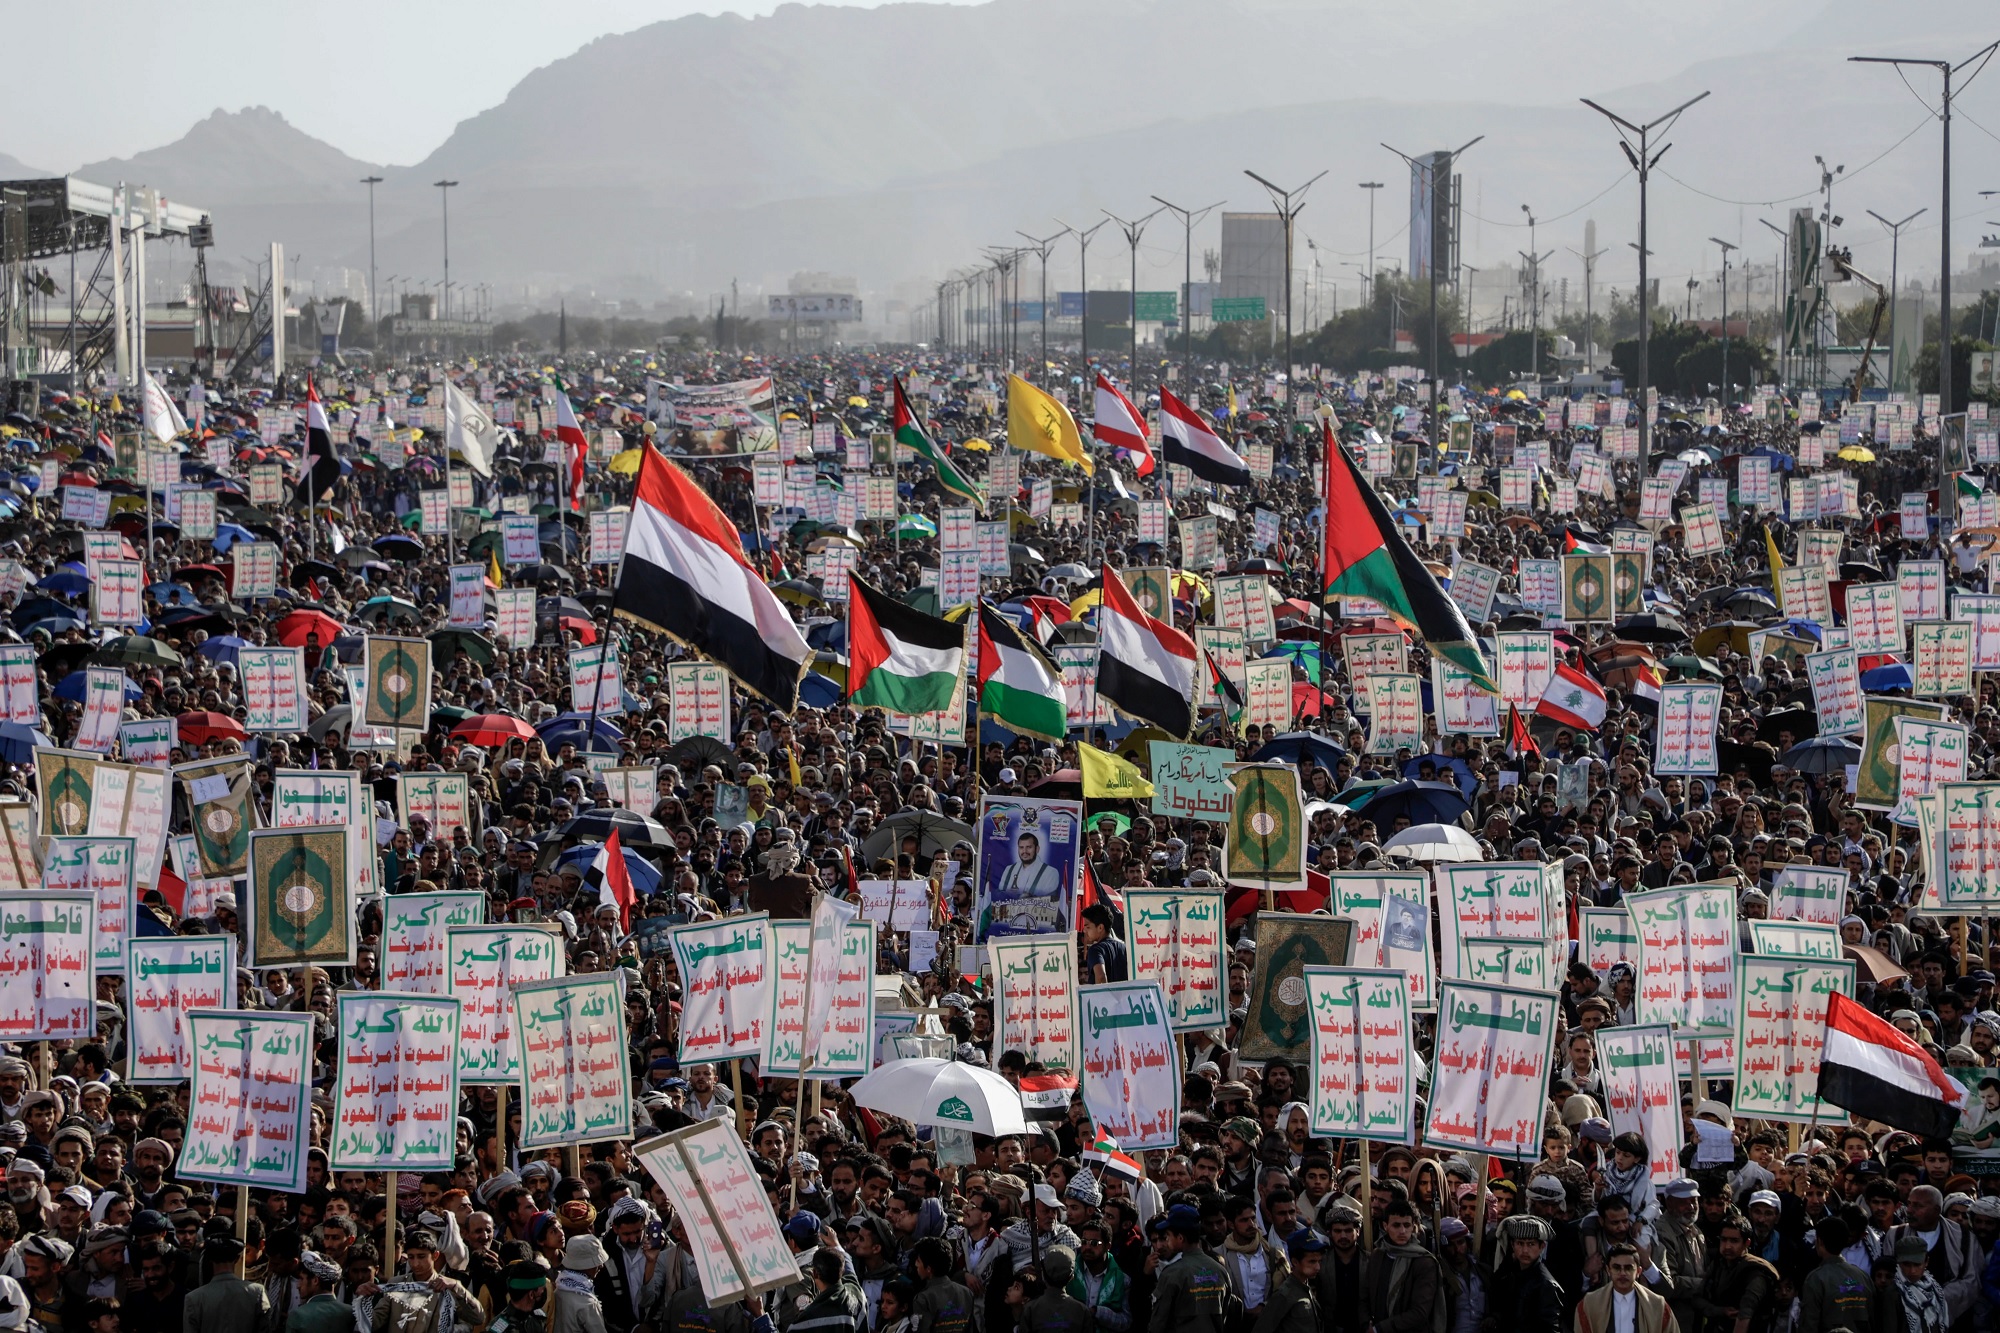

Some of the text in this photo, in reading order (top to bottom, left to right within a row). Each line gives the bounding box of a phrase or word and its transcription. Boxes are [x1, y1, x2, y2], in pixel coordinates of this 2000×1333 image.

[101, 566, 137, 579] قاطعوا
[1901, 567, 1937, 579] قاطعوا
[1921, 627, 1967, 643] الله أكبر
[1502, 639, 1547, 655] قاطعوا
[245, 653, 293, 671] الله أكبر
[676, 668, 720, 686] الله أكبر
[1666, 688, 1715, 709] الله أكبر
[124, 728, 168, 747] قاطعوا
[1904, 729, 1962, 750] الله أكبر
[1181, 756, 1205, 782] أمريكا
[1936, 756, 1961, 768] الموت
[280, 785, 346, 808] قاطعوا
[1172, 786, 1232, 816] الخطوط
[1457, 872, 1539, 904] الله أكبر
[389, 900, 477, 935] الله أكبر
[1134, 896, 1217, 927] الله أكبر
[1505, 907, 1539, 924] الموت
[1640, 892, 1729, 927] الله أكبر
[681, 928, 762, 968] قاطعوا
[1181, 931, 1216, 947] الموت
[1691, 930, 1729, 949] الموت
[0, 943, 86, 975] البضائع الأمريكي
[455, 933, 550, 969] الله أكبر
[1182, 953, 1217, 970] الموت
[135, 950, 220, 981] قاطعوا
[1004, 949, 1067, 981] الله أكبر
[1474, 946, 1540, 980] الله أكبر
[1693, 957, 1730, 975] الموت
[35, 977, 42, 999] و
[726, 964, 762, 990] البضائع
[1169, 977, 1186, 995] على
[1190, 976, 1217, 990] اللعنة
[182, 988, 220, 1011] البضائع
[1040, 981, 1068, 999] الموت
[1315, 977, 1401, 1013] الله أكبر
[1643, 982, 1732, 1002] اللعنة على اليهود
[524, 989, 613, 1032] الله أكبر
[719, 997, 724, 1015] و
[1040, 1006, 1069, 1021] الموت
[1088, 995, 1158, 1039] قاطعوا
[1181, 995, 1218, 1022] النصر
[1449, 991, 1542, 1035] قاطعوا
[175, 1017, 180, 1035] و
[347, 1002, 453, 1043] الله أكبر
[1363, 1019, 1402, 1040] الموت
[200, 1023, 300, 1055] الله أكبر
[577, 1025, 616, 1046] الموت
[1030, 1028, 1044, 1046] على
[1049, 1028, 1070, 1042] اللعنة
[405, 1044, 450, 1066] الموت
[579, 1053, 619, 1074] الموت
[1130, 1040, 1170, 1075] البضائع
[1364, 1048, 1403, 1068] الموت
[1494, 1046, 1543, 1082] البضائع
[1603, 1034, 1664, 1076] قاطعوا
[254, 1067, 298, 1087] الموت
[404, 1074, 449, 1096] الموت
[1320, 1073, 1402, 1096] اللعنة على اليهود
[531, 1080, 621, 1109] اللعنة على اليهود
[1028, 1092, 1063, 1104] في قلوبنا
[1123, 1077, 1130, 1103] و
[1480, 1080, 1488, 1104] و
[251, 1095, 295, 1114] الموت
[342, 1103, 448, 1126] اللعنة على اليهود
[1364, 1099, 1401, 1130] النصر
[194, 1113, 293, 1141] اللعنة على اليهود
[581, 1103, 621, 1134] النصر
[398, 1127, 446, 1161] النصر
[243, 1147, 292, 1175] النصر
